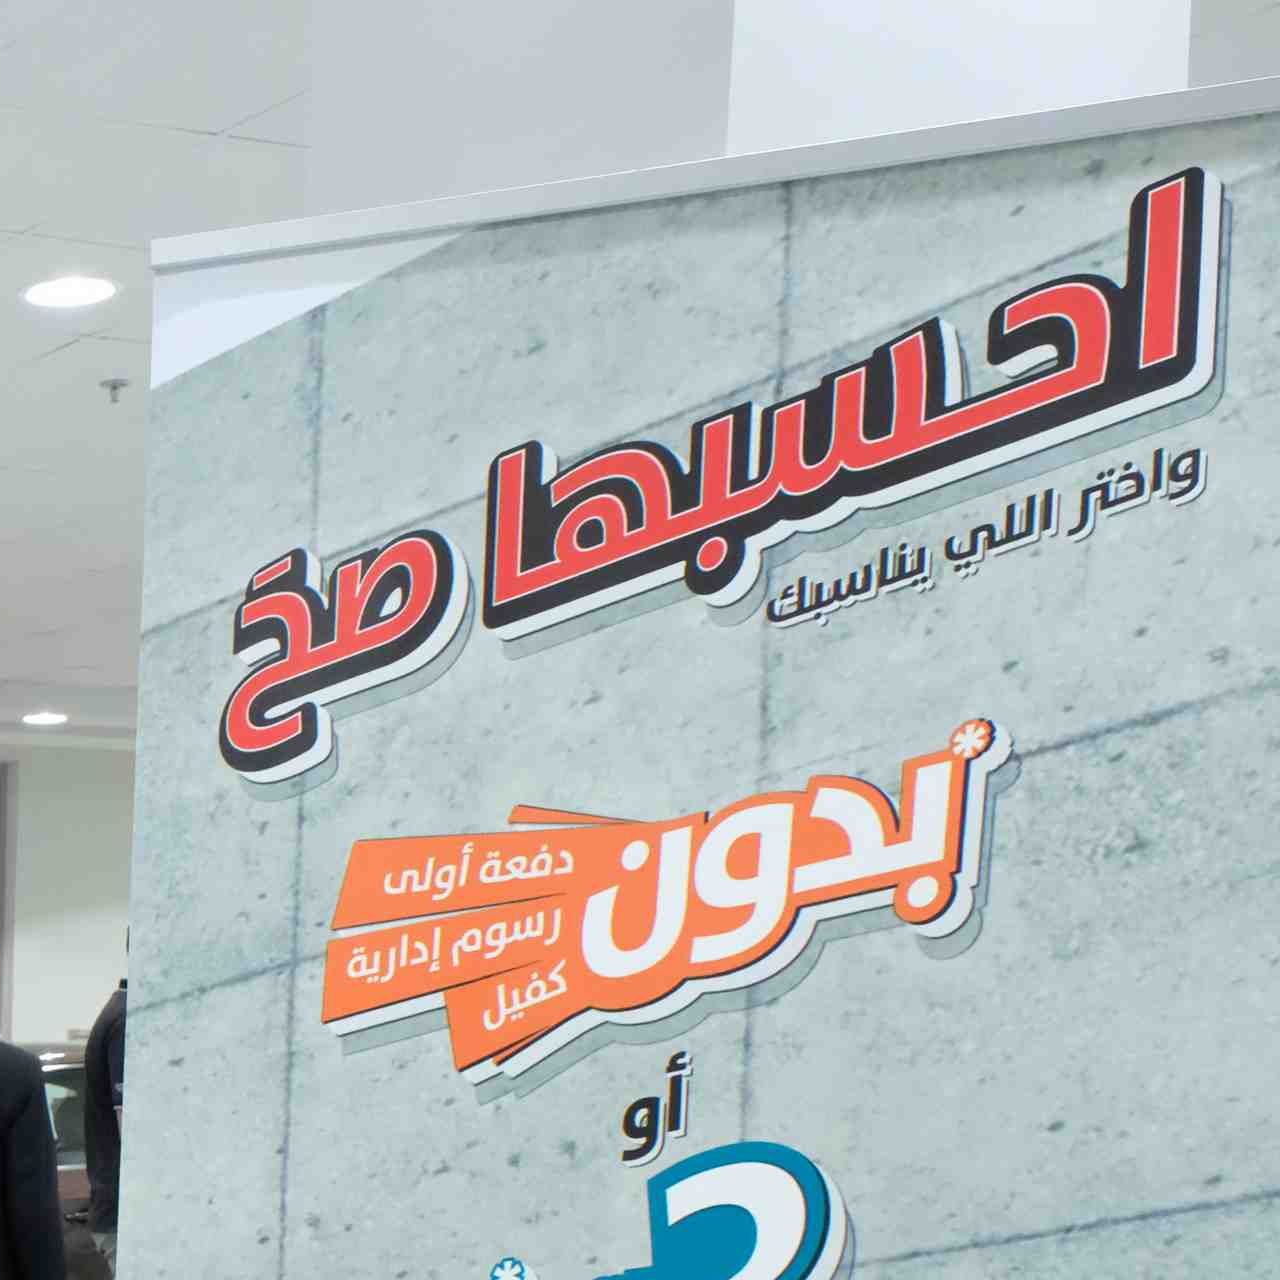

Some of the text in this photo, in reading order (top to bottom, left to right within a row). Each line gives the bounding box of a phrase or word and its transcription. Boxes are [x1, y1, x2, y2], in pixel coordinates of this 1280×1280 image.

[486, 169, 1202, 622] احسبها
[766, 447, 1203, 623] واختر اللي يناسبك
[383, 842, 574, 901] دفعة أولى
[581, 758, 954, 979] بدون
[346, 907, 562, 984] رسوم إدارية
[482, 959, 568, 1031] كفيل
[621, 1050, 690, 1161] أو
